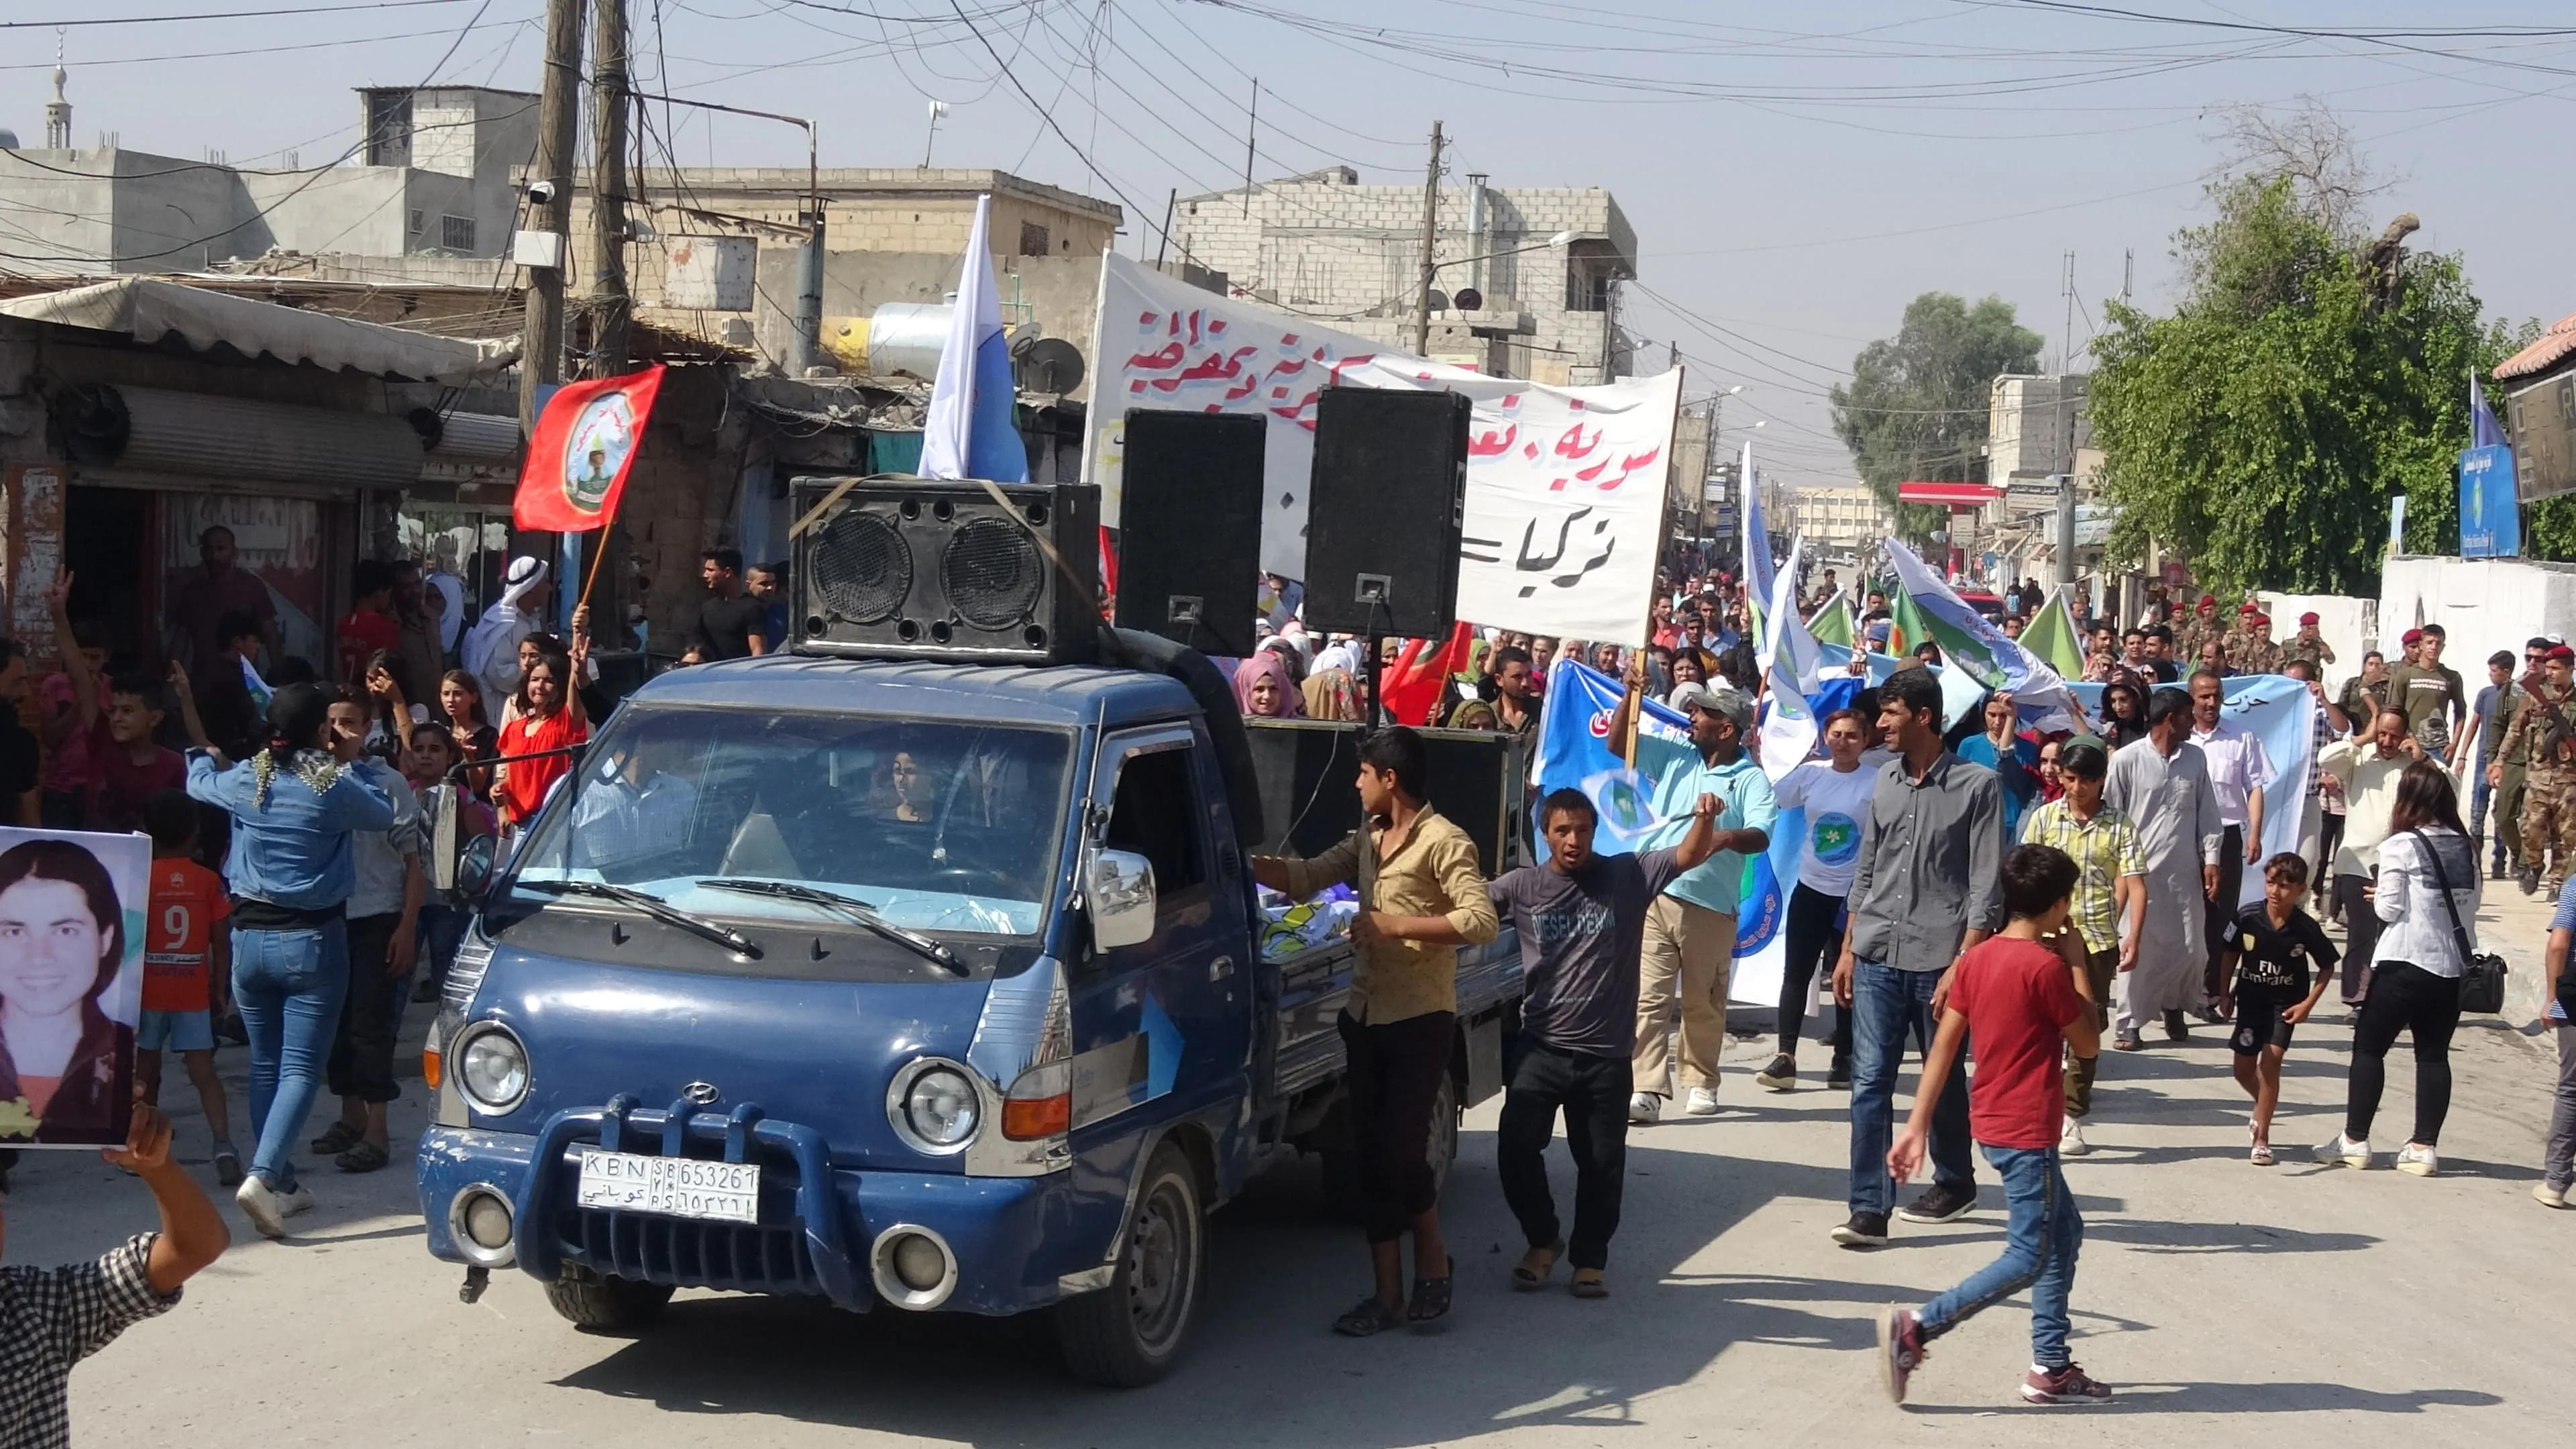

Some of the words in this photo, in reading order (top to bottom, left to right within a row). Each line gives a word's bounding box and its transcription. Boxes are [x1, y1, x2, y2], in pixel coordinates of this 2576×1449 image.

[1550, 398, 1659, 492] سورية
[1516, 506, 1615, 598] تركيا
[2223, 694, 2270, 714] حزب
[164, 905, 190, 950] 9
[1531, 914, 1576, 943] DIESEL
[584, 1156, 645, 1177] KBN
[681, 1164, 755, 1189] 653261
